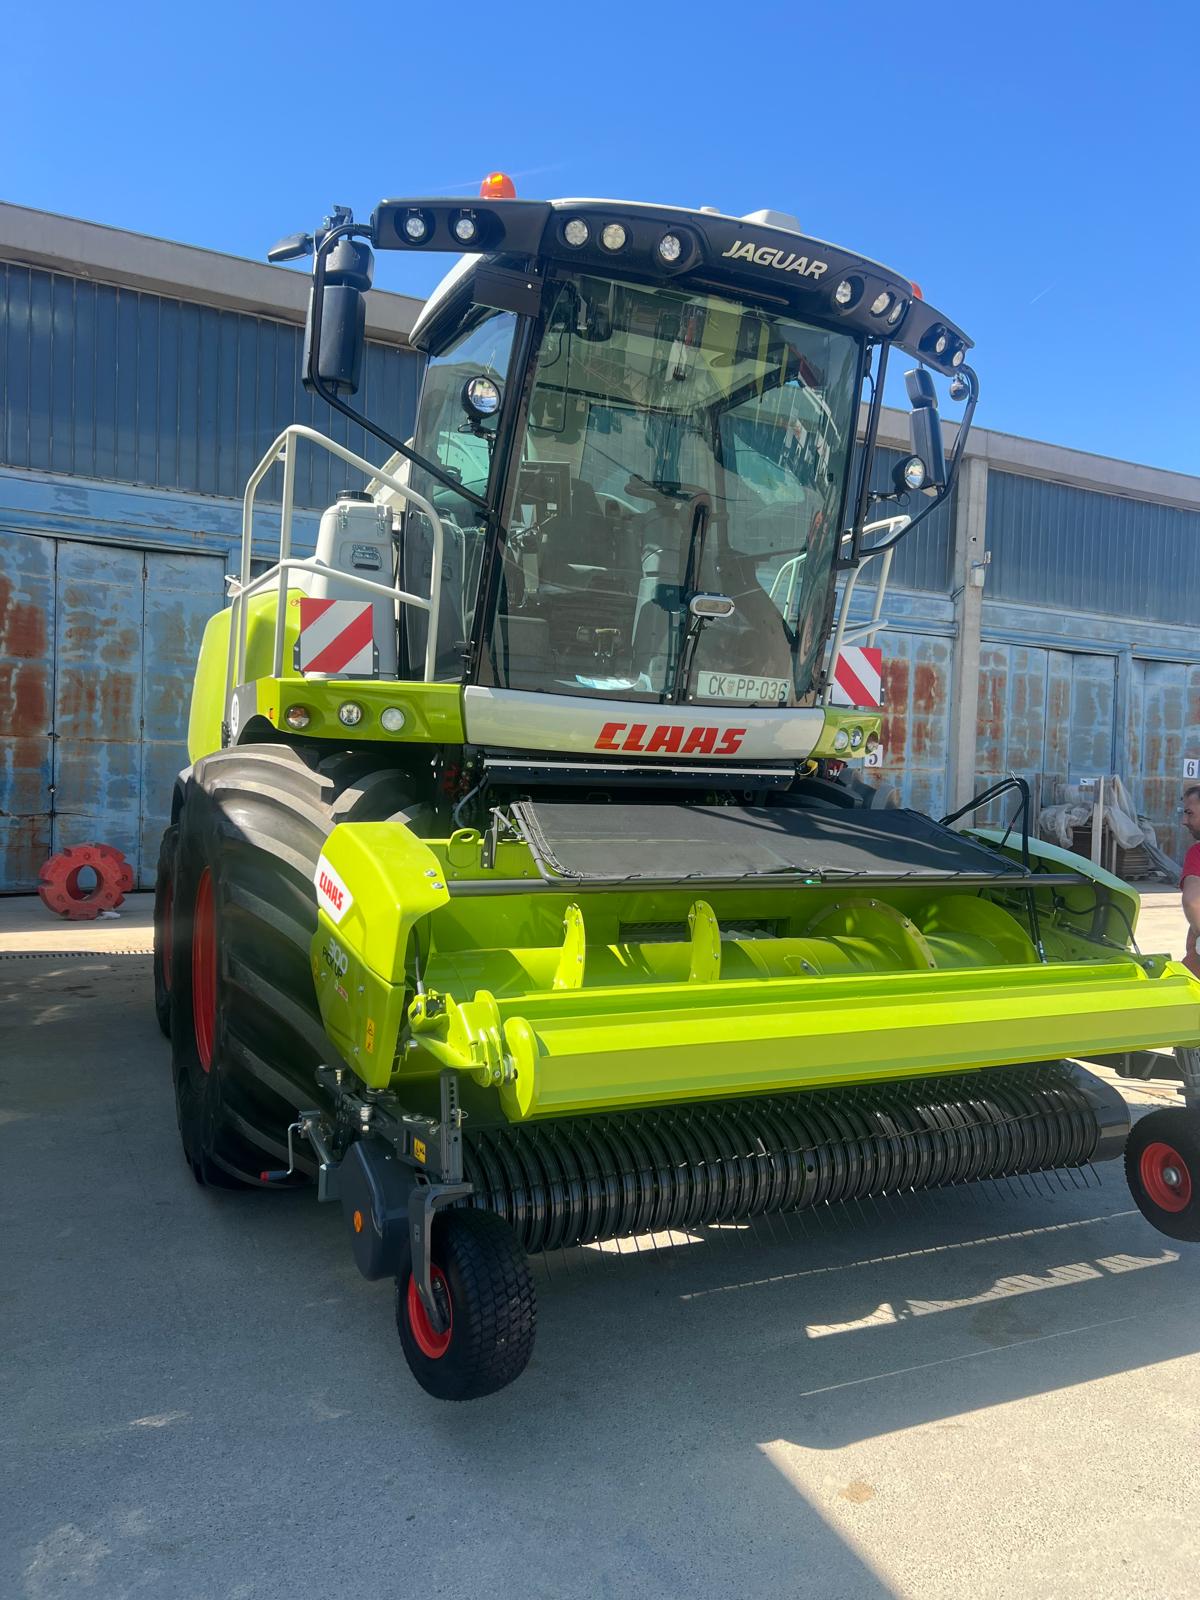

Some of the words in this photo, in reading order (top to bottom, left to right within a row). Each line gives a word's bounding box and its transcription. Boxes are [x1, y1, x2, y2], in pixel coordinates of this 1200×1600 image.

[721, 240, 829, 280] JAGUAR
[708, 675, 727, 697] CK
[594, 722, 747, 755] CLAAS
[1186, 760, 1195, 777] 6
[319, 871, 344, 911] CLAAS
[328, 936, 349, 975] 300
